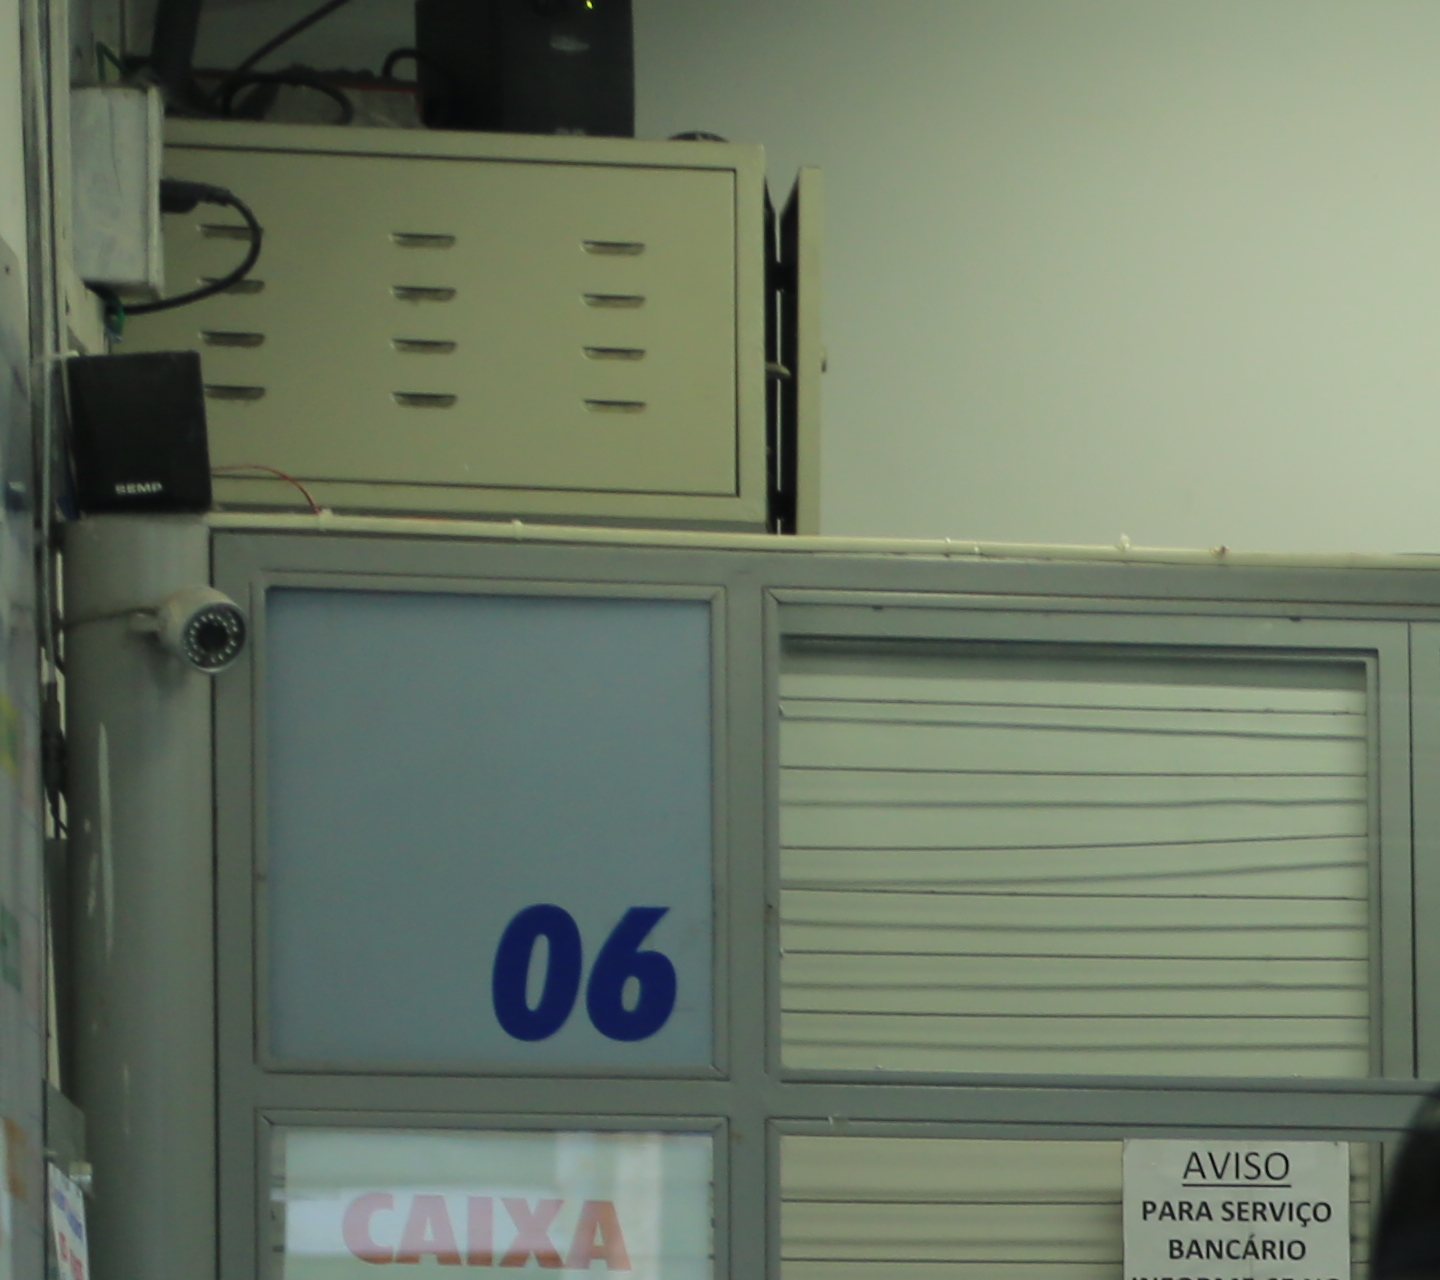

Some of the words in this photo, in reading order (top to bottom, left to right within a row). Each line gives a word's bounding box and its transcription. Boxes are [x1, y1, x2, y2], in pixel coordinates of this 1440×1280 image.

[492, 904, 677, 1042] 06
[1182, 1152, 1291, 1181] AVISO
[1142, 1200, 1213, 1222] PARA
[1221, 1201, 1333, 1227] SERVIÇO
[342, 1192, 632, 1271] CAIXA
[1168, 1235, 1307, 1260] BANCÁRIO
